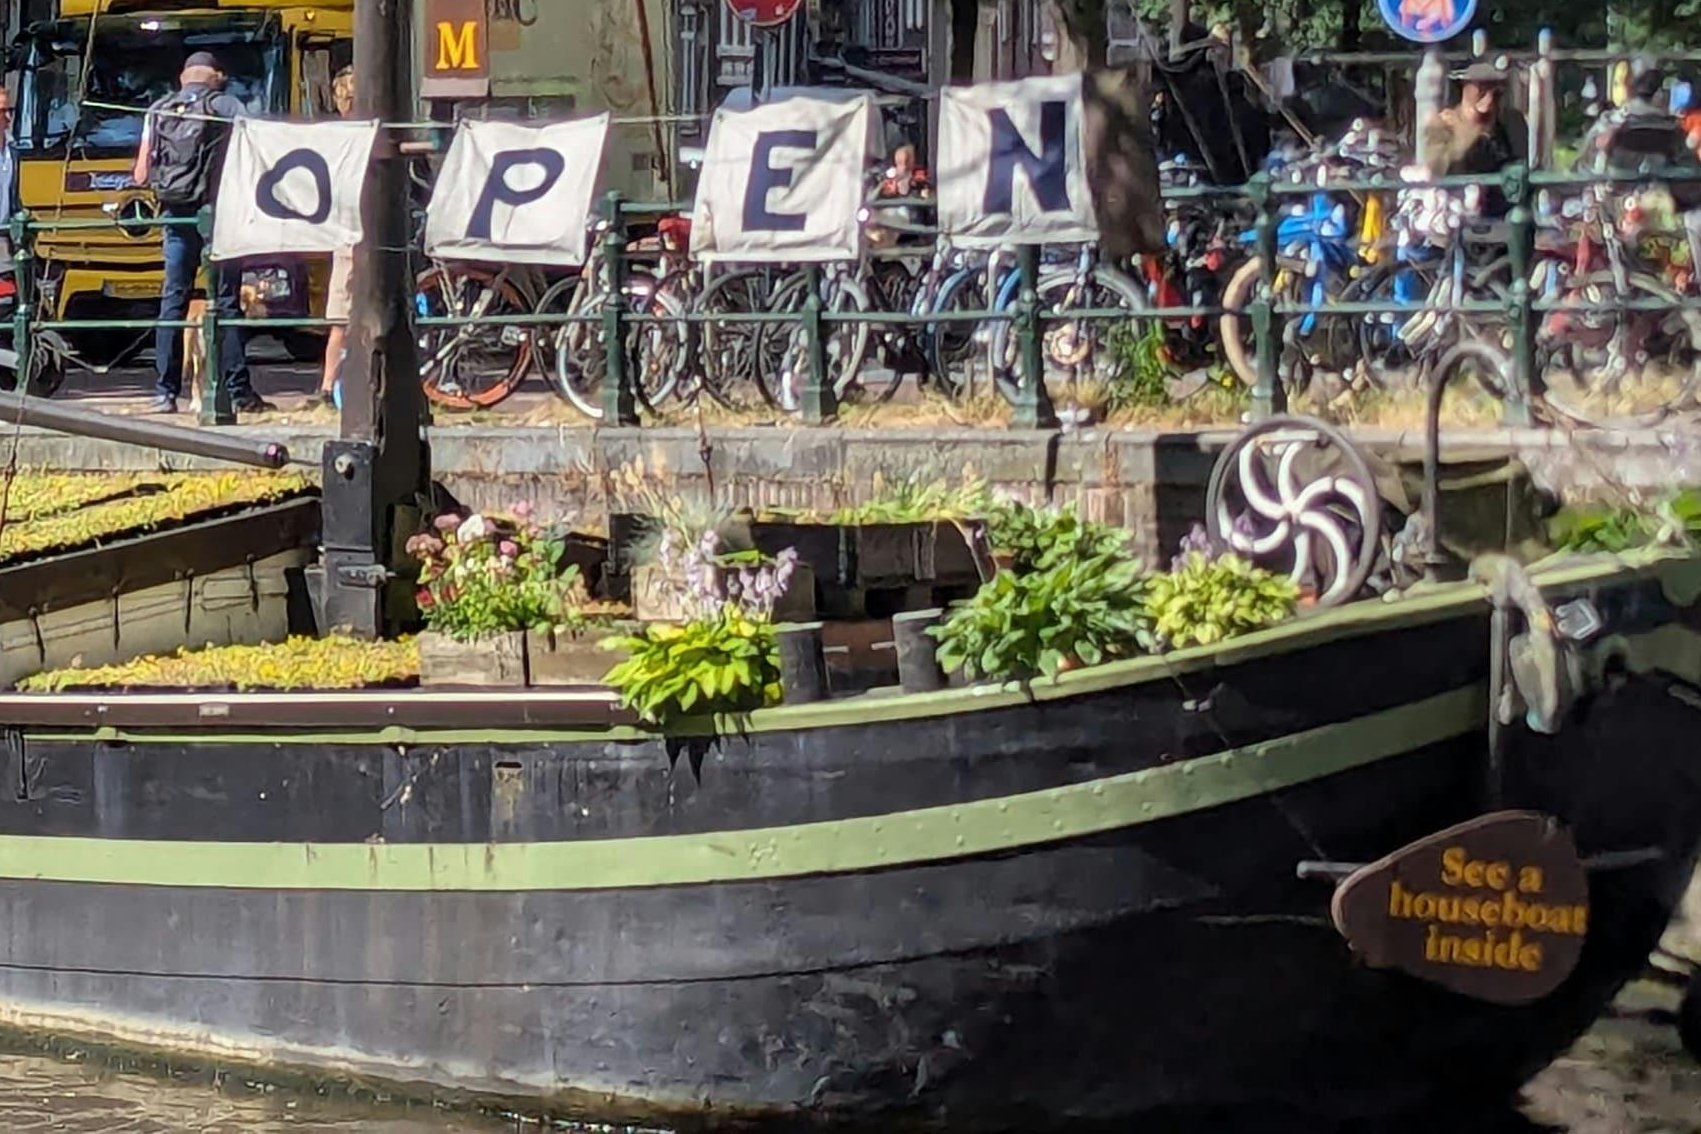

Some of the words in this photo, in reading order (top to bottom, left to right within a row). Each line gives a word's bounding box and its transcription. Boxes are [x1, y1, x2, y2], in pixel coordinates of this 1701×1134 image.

[255, 100, 1072, 241] OPEN
[1441, 846, 1511, 891] See
[1517, 865, 1544, 893] a
[1424, 924, 1543, 972] inside
